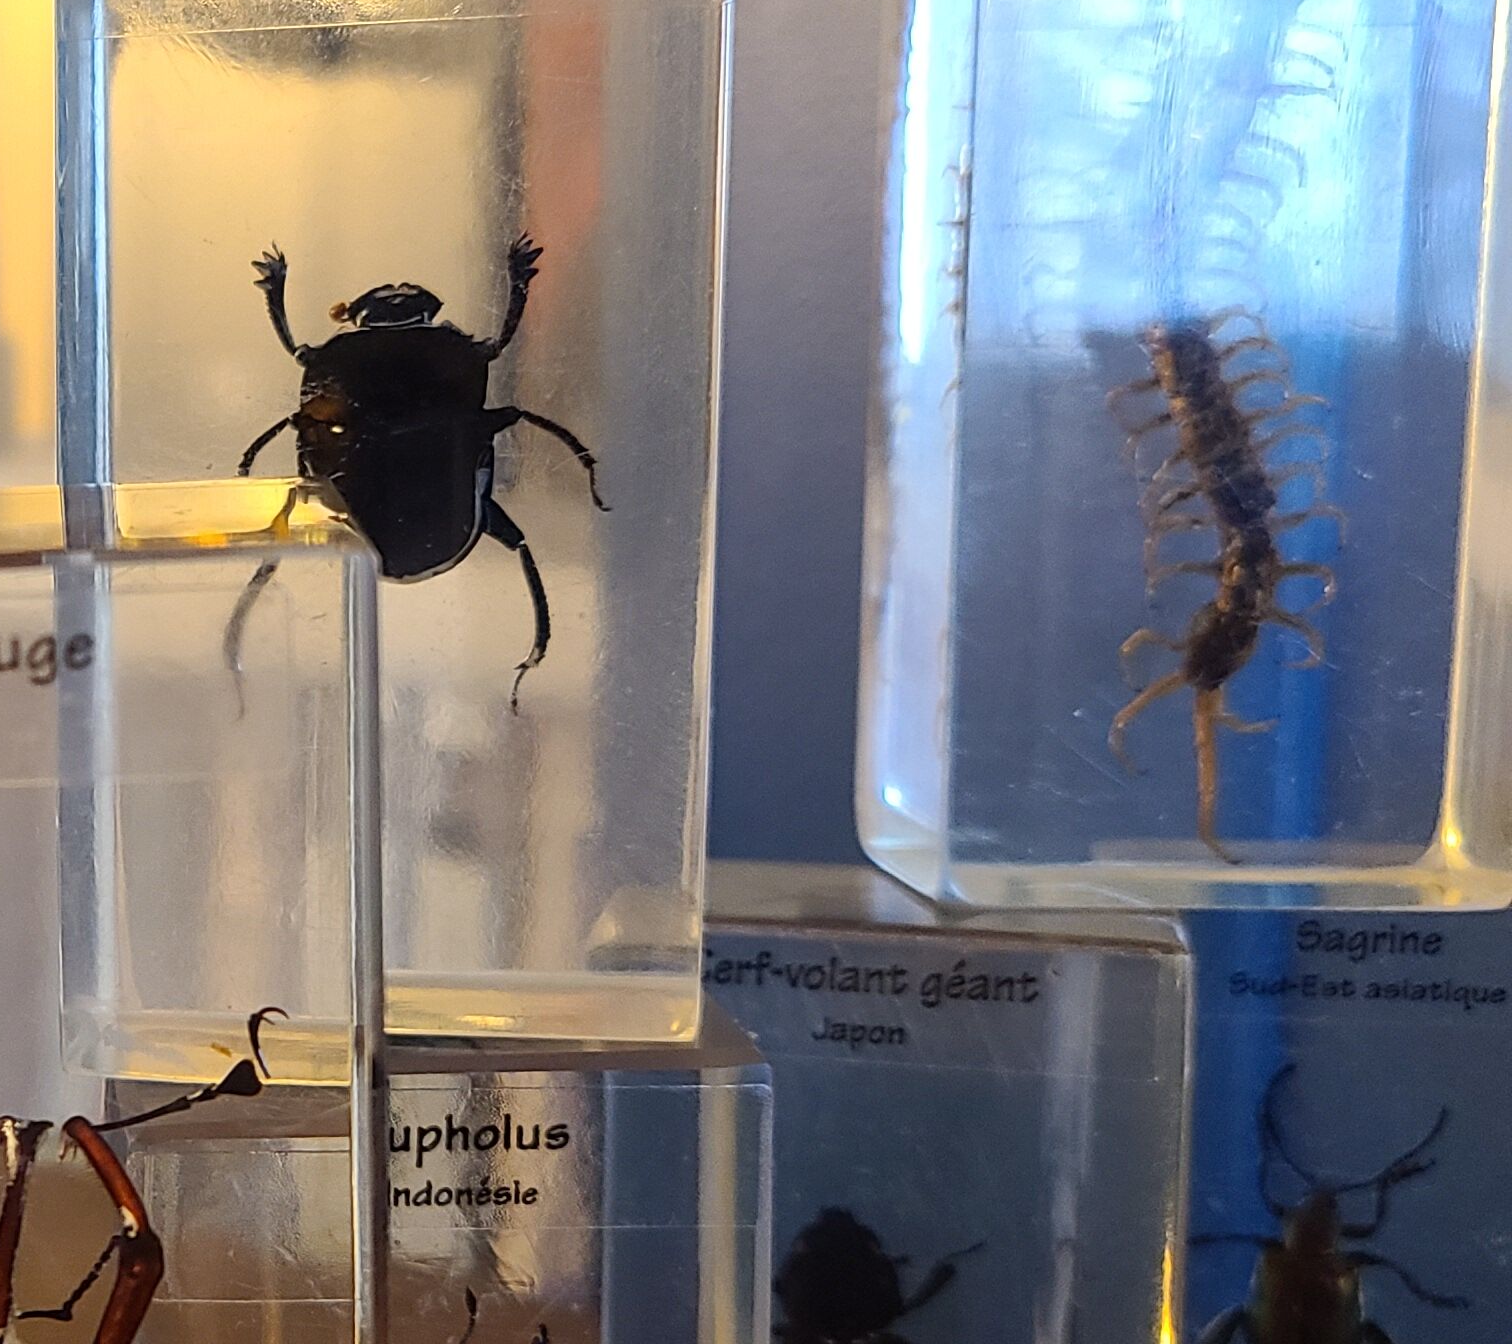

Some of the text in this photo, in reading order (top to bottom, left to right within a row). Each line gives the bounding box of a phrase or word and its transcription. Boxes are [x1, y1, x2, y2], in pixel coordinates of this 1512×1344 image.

[1296, 919, 1444, 963] Sagrine
[920, 959, 1041, 1008] géant
[1228, 971, 1507, 1011] Sud-Est asiatique
[811, 1017, 906, 1050] Japon
[388, 1114, 570, 1168] upholus
